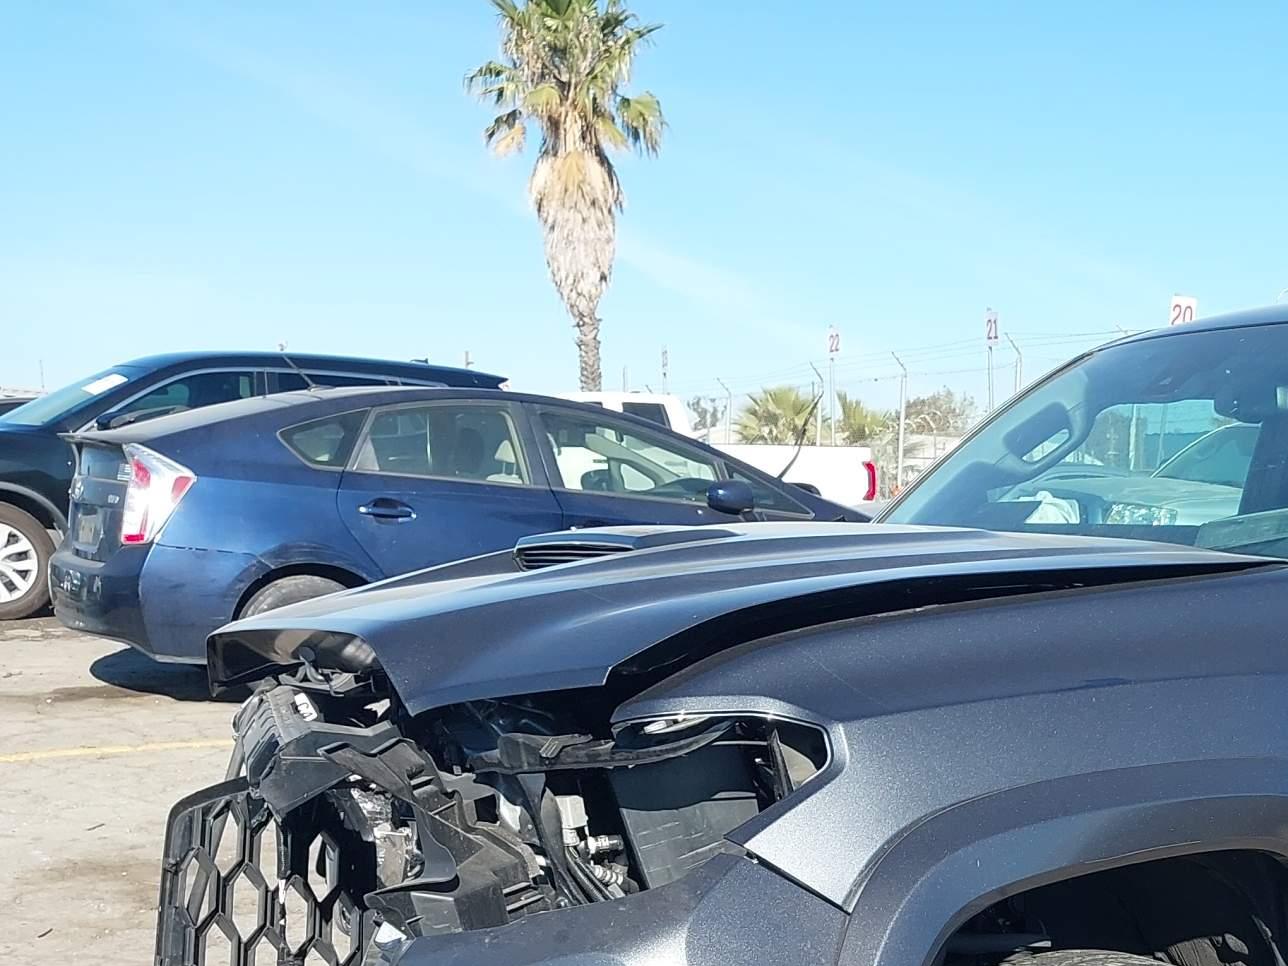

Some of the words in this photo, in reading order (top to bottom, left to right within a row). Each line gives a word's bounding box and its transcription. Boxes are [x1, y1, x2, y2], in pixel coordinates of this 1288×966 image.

[1171, 304, 1193, 325] 20
[986, 319, 999, 340] 21
[829, 333, 840, 353] 22
